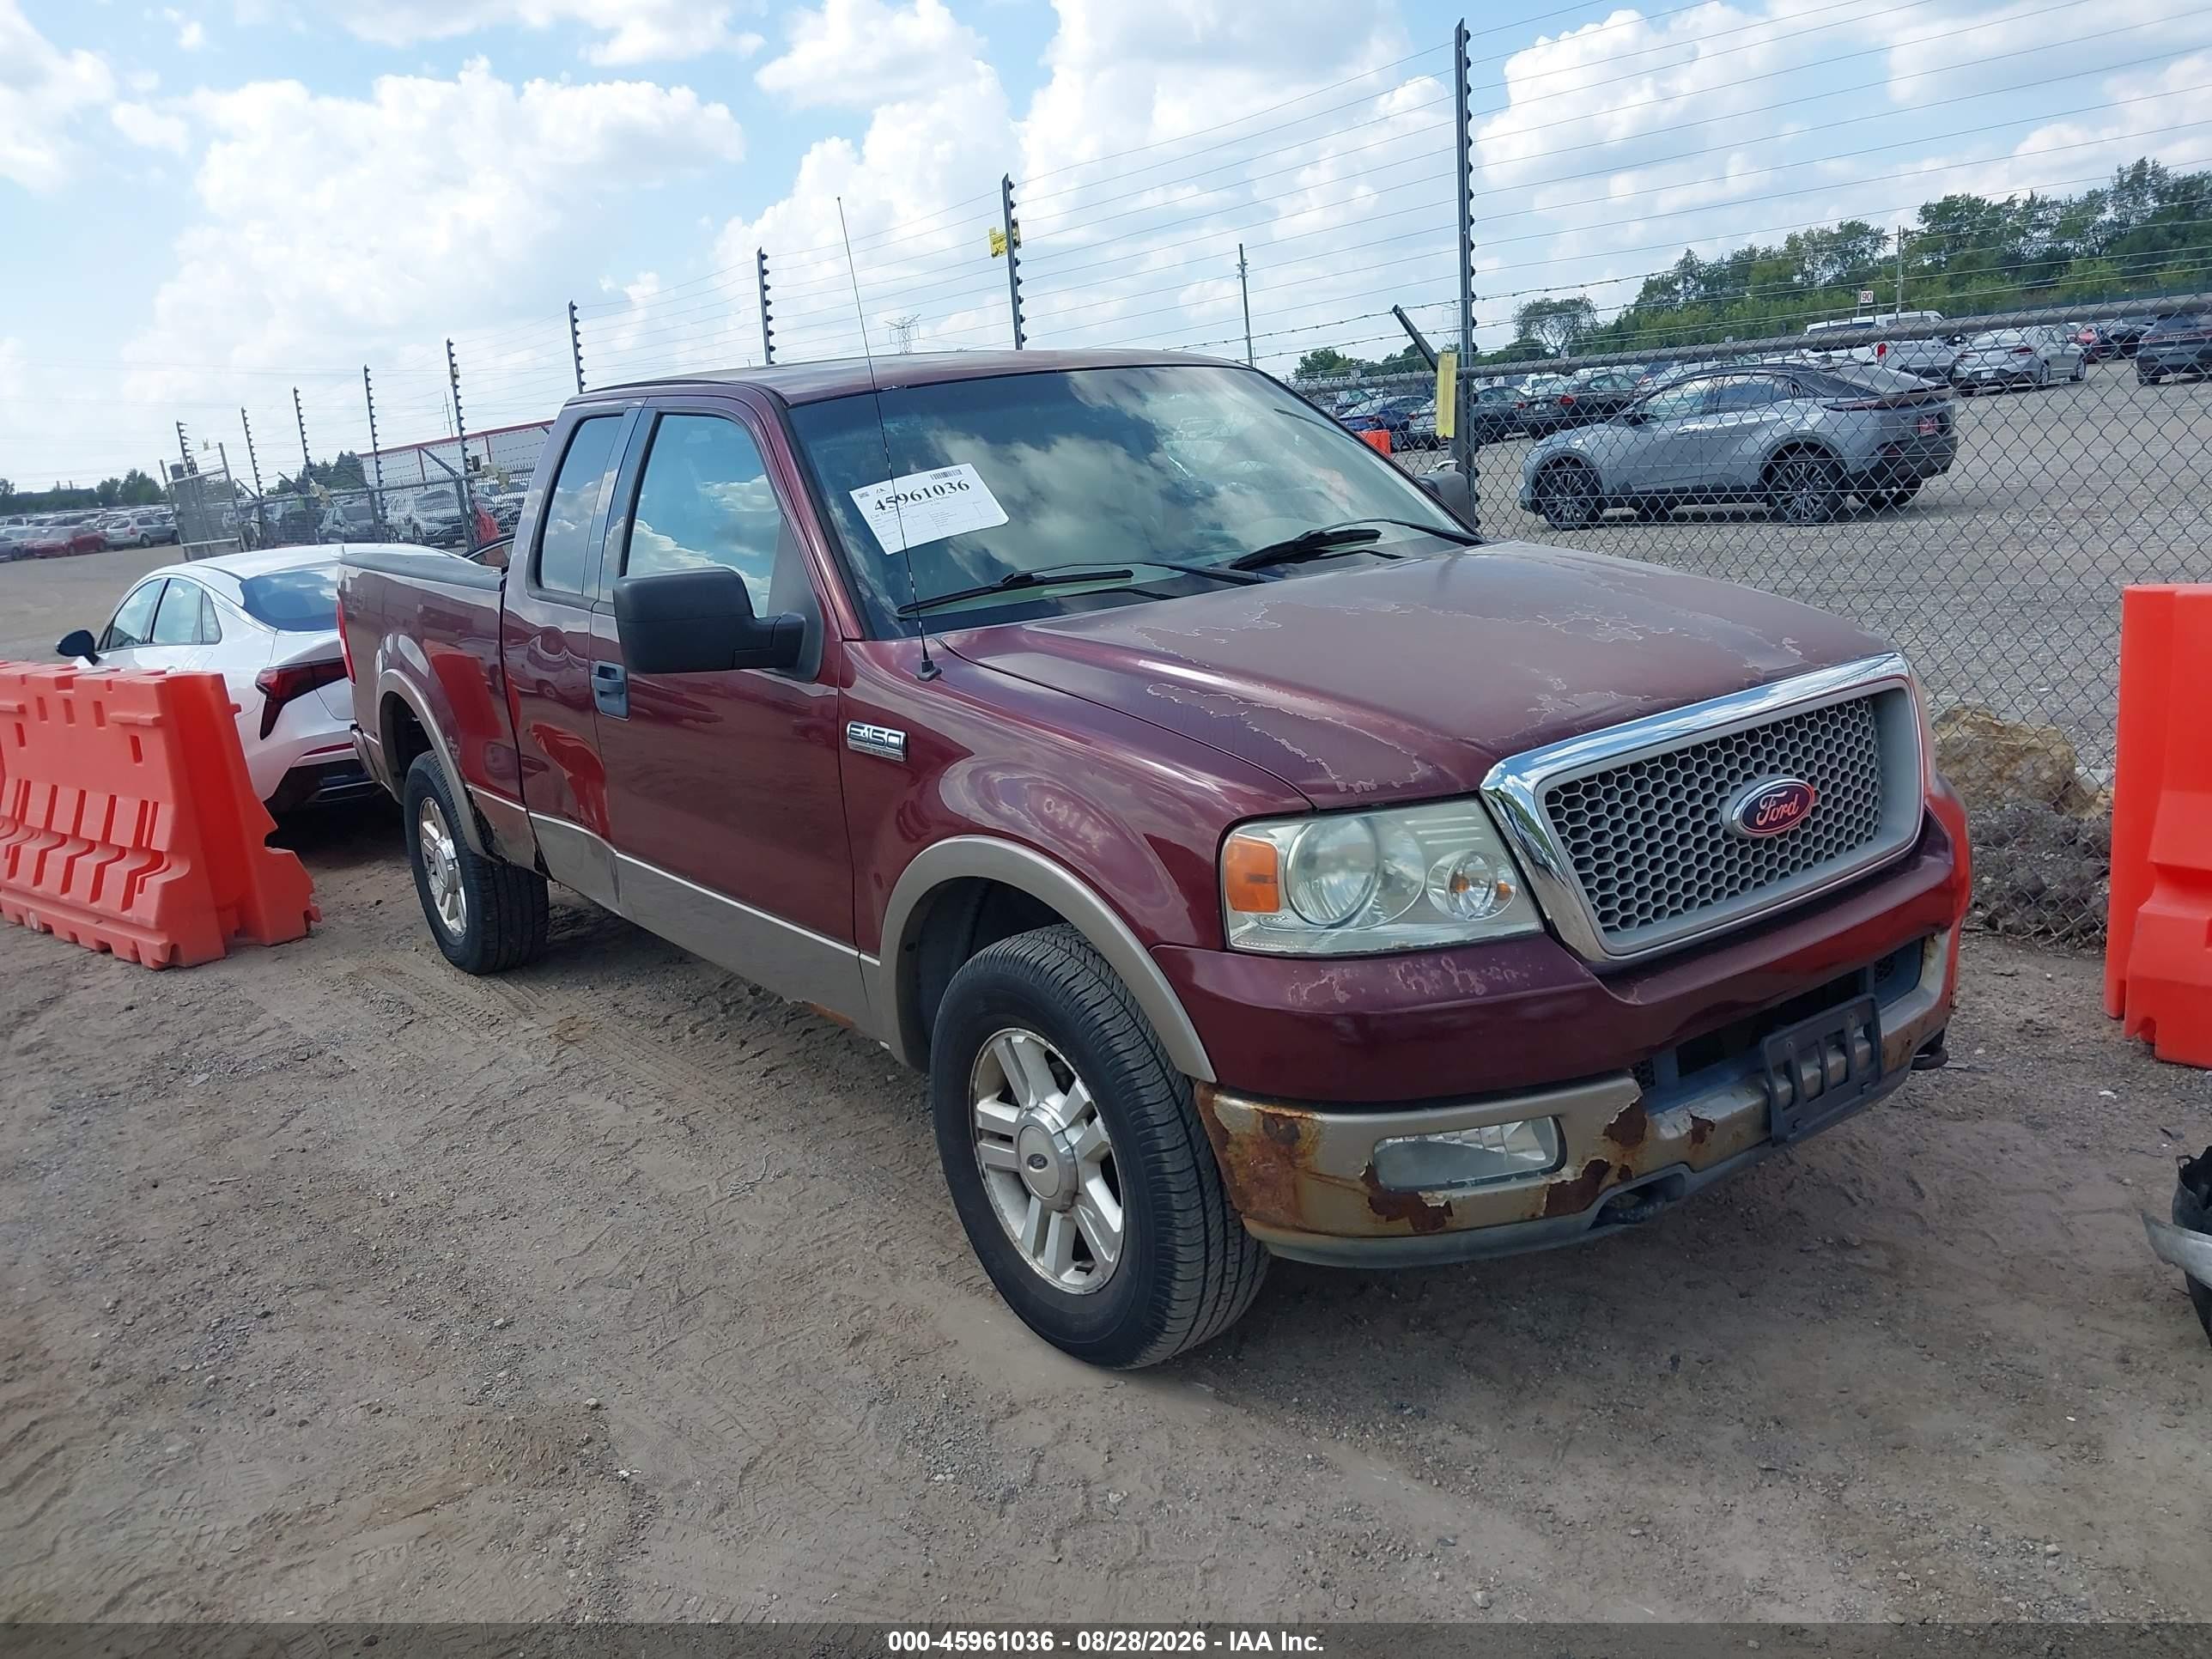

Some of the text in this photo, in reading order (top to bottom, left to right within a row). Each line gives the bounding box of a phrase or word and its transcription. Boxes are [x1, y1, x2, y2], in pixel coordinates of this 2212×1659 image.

[1862, 292, 1872, 301] 90
[874, 479, 970, 513] 45961036
[1756, 790, 1799, 826] Ford
